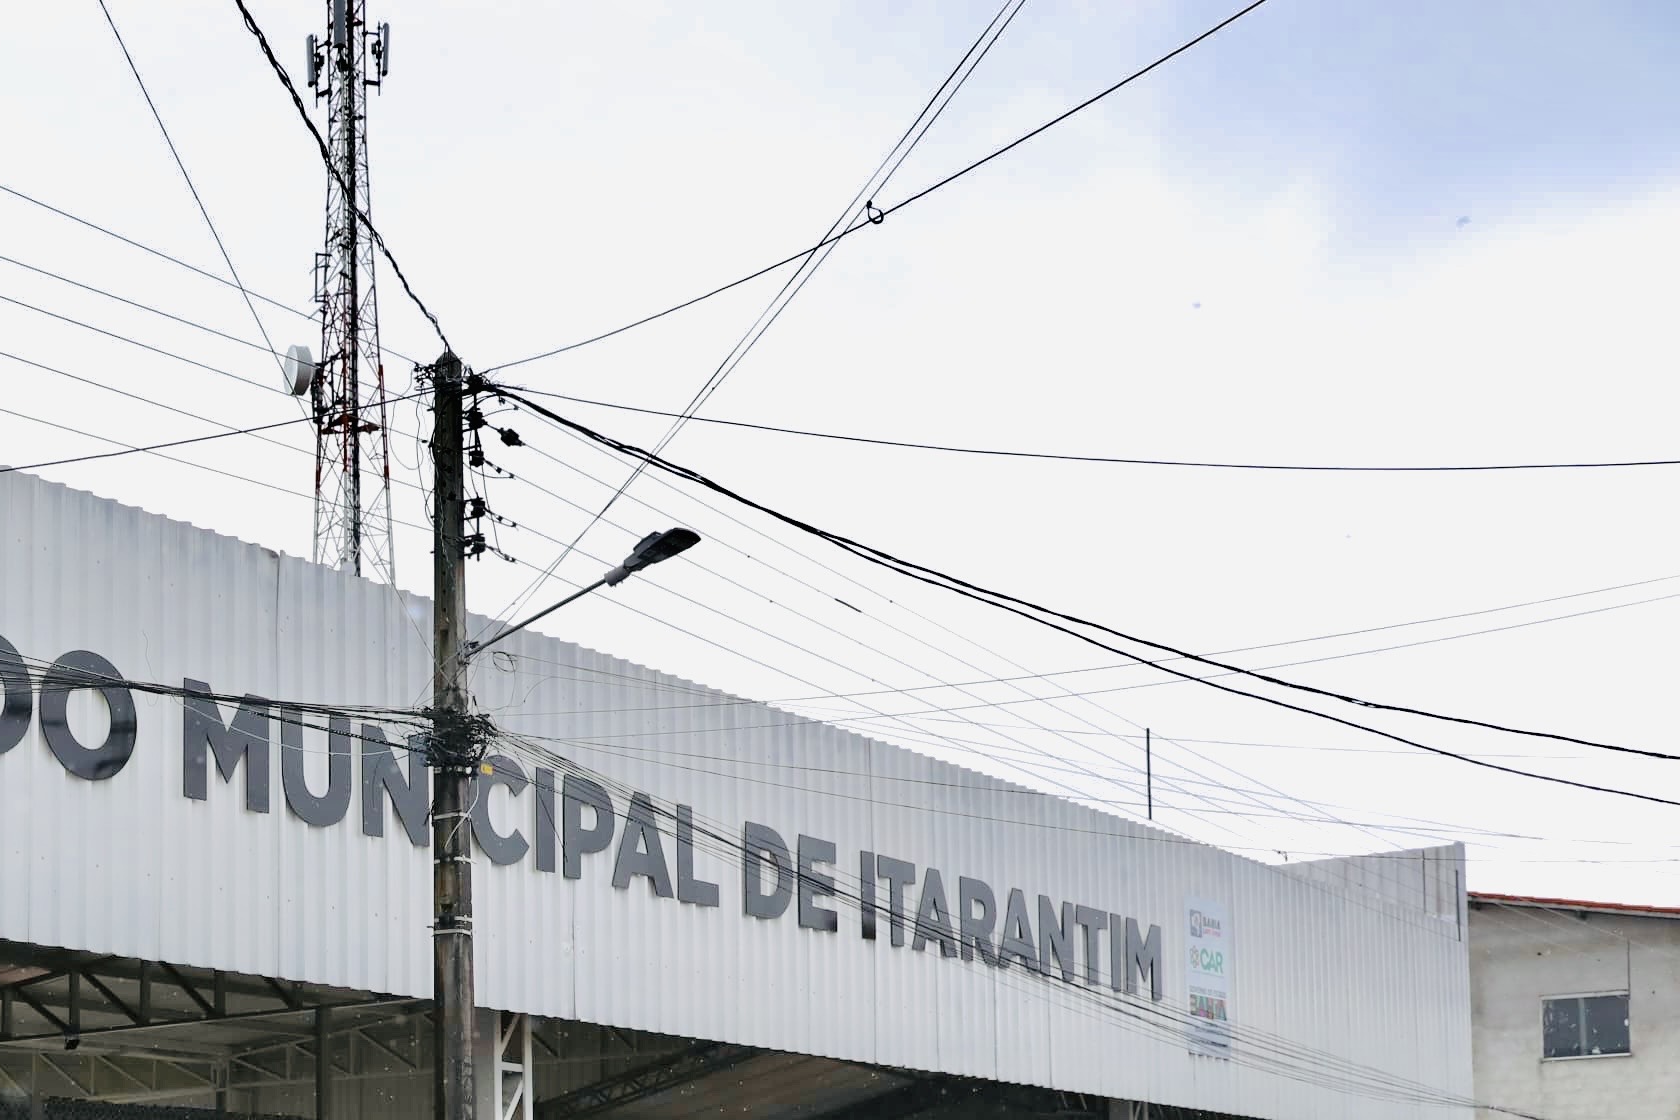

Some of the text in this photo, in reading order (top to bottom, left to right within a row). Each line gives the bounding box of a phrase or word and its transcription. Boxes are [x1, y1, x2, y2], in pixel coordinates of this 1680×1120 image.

[183, 677, 720, 907] MUNCIPAL
[744, 820, 838, 933] DE
[860, 849, 1163, 1001] ITARANTIM
[1200, 948, 1224, 974] CAR
